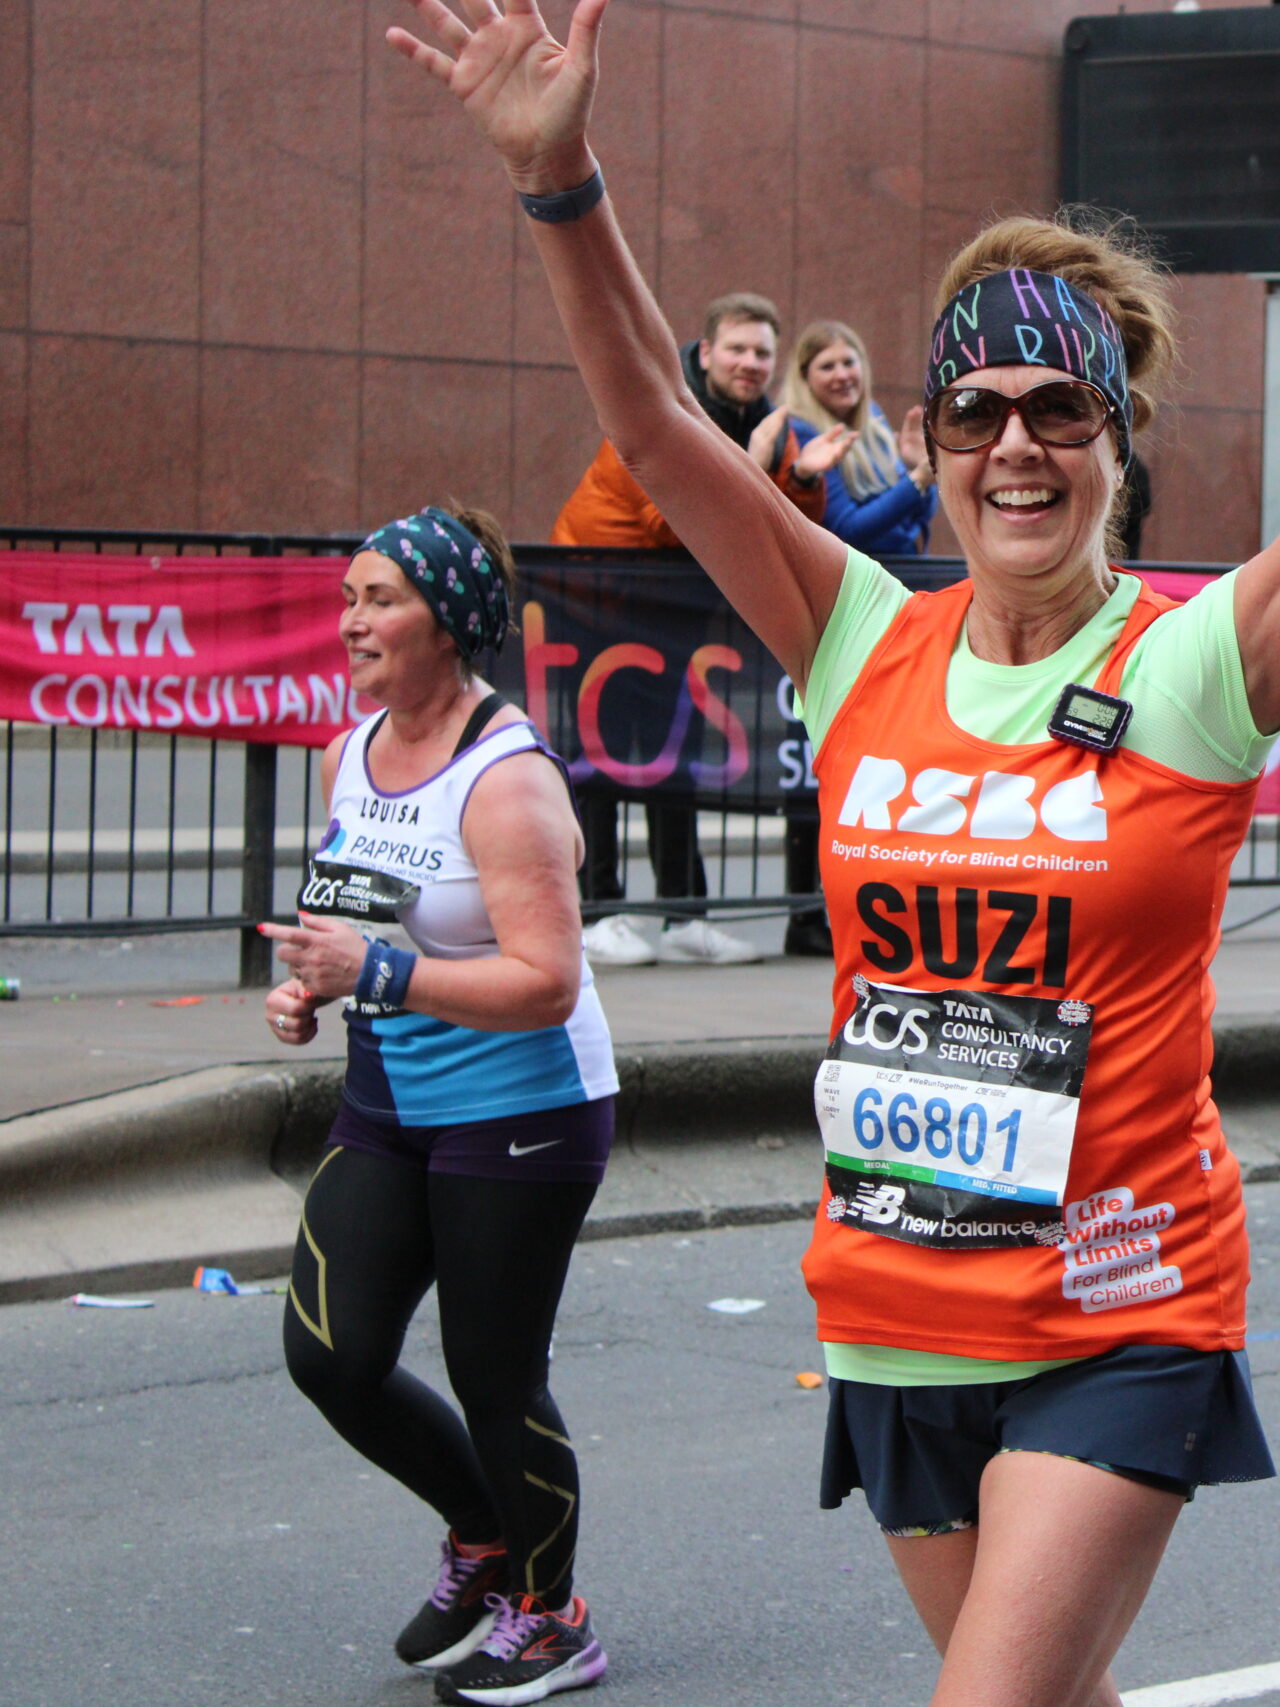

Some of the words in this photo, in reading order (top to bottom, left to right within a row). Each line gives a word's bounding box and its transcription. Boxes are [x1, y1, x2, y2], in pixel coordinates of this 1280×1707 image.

[21, 601, 195, 657] TATA
[29, 672, 377, 727] CONSULTANC
[522, 601, 749, 788] tcs
[360, 798, 420, 826] LOUISA
[838, 756, 1107, 841] RSBC
[350, 835, 444, 871] PAPYRUS
[831, 840, 866, 861] Royal
[869, 845, 940, 867] Society
[939, 850, 967, 865] for
[970, 852, 1018, 868] Blind
[1022, 853, 1108, 872] Children
[302, 859, 343, 907] tcs
[337, 897, 370, 912] SERVICES
[856, 882, 1072, 988] SUZI
[843, 998, 930, 1054] tcs
[943, 1000, 994, 1024] TATA
[941, 1022, 1072, 1055] CONSULTANCY
[937, 1043, 1019, 1069] SERVICES
[823, 1087, 840, 1096] WAVE
[908, 1076, 968, 1092] #WeRunTogether
[853, 1087, 1022, 1173] 66801
[863, 1160, 891, 1170] MEDAL
[992, 1184, 1018, 1195] FITTED
[1078, 1196, 1124, 1222] Life
[900, 1212, 939, 1237] new
[940, 1218, 1035, 1238] balance
[1074, 1237, 1154, 1266] Limits
[1072, 1273, 1102, 1290] For
[1107, 1258, 1154, 1282] Blind
[1090, 1276, 1175, 1305] Children
